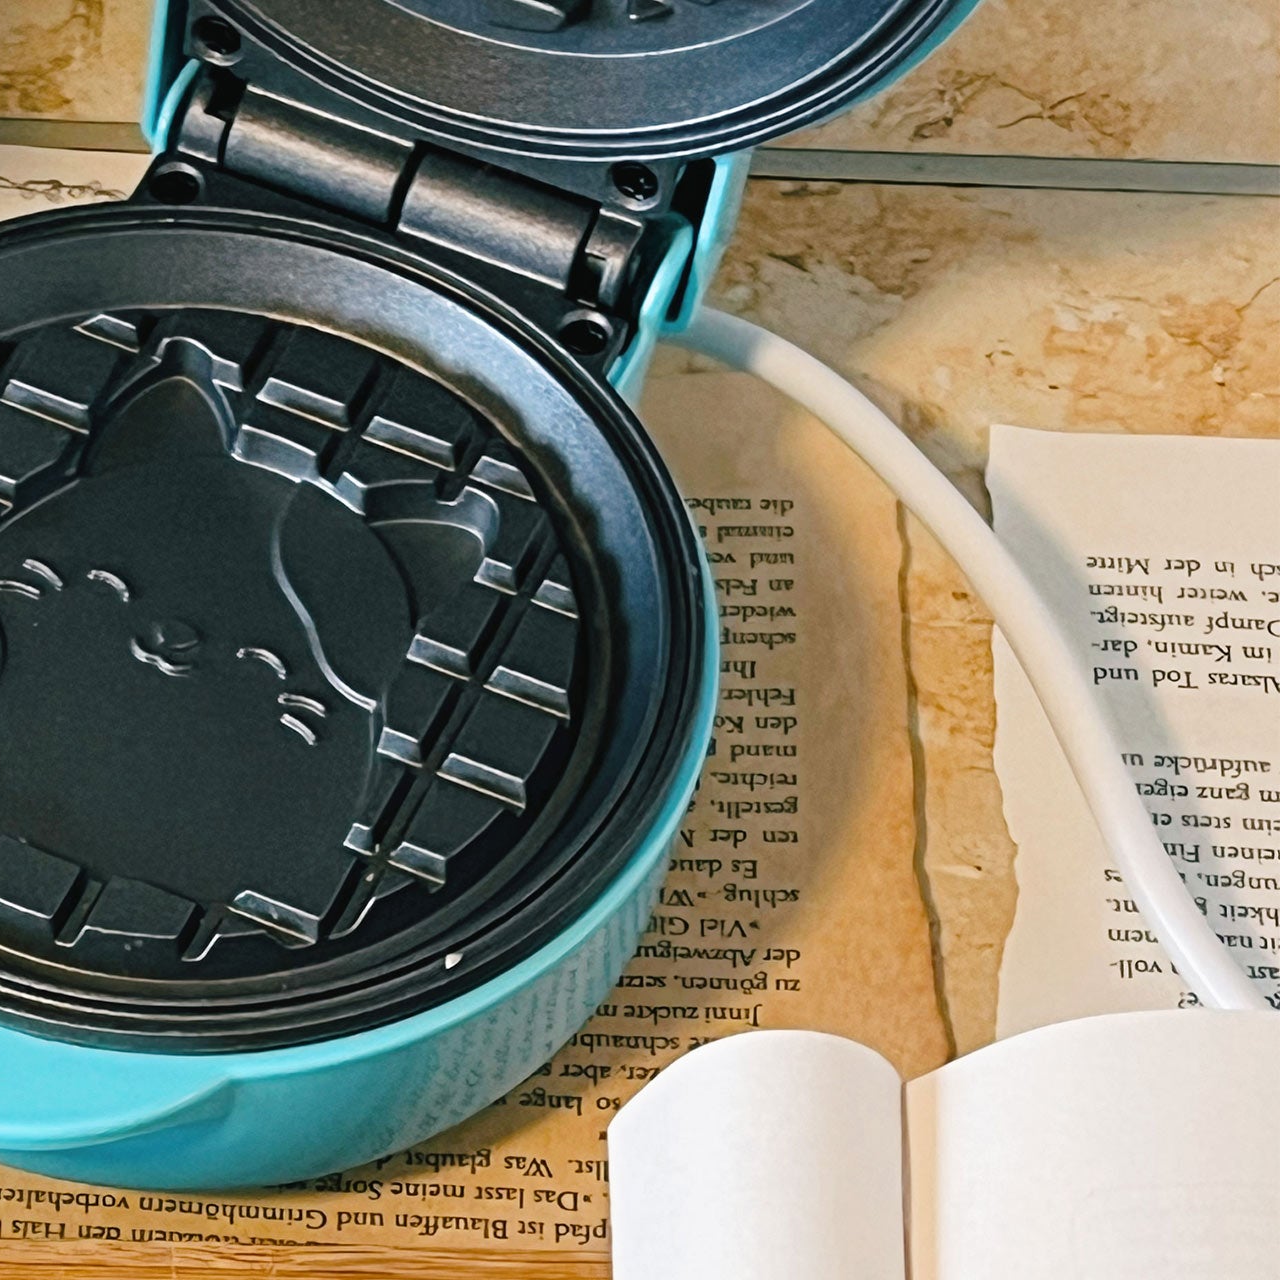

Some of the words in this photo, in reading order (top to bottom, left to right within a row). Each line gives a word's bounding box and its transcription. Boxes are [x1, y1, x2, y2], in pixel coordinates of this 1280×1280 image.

[1087, 557, 1149, 575] Mitte
[1164, 559, 1200, 577] der
[1215, 562, 1234, 577] in
[1089, 585, 1163, 604] hinten
[1177, 587, 1248, 601] weiter
[1090, 606, 1194, 632] aufsteigt.
[1092, 640, 1137, 658] dar-
[1147, 640, 1231, 662] Kamin,
[1242, 646, 1271, 663] im
[1093, 667, 1138, 685] und
[1152, 670, 1198, 689] Tod
[755, 716, 797, 735] den
[730, 744, 797, 763] mand
[709, 829, 747, 849] der
[731, 859, 757, 879] Es
[763, 948, 800, 968] der
[776, 979, 800, 991] zu
[624, 1006, 699, 1026] zuckte
[704, 1004, 763, 1027] Jinni
[518, 1087, 582, 1116] lange
[402, 1147, 491, 1177] glaubst
[504, 1156, 553, 1178] Was
[388, 1180, 465, 1202] meine
[474, 1186, 524, 1209] lasst
[533, 1190, 592, 1212] »Das
[139, 1195, 327, 1232] Grimmhörnern
[337, 1211, 384, 1231] und
[395, 1214, 508, 1239] Blauaffen
[517, 1220, 544, 1240] ist
